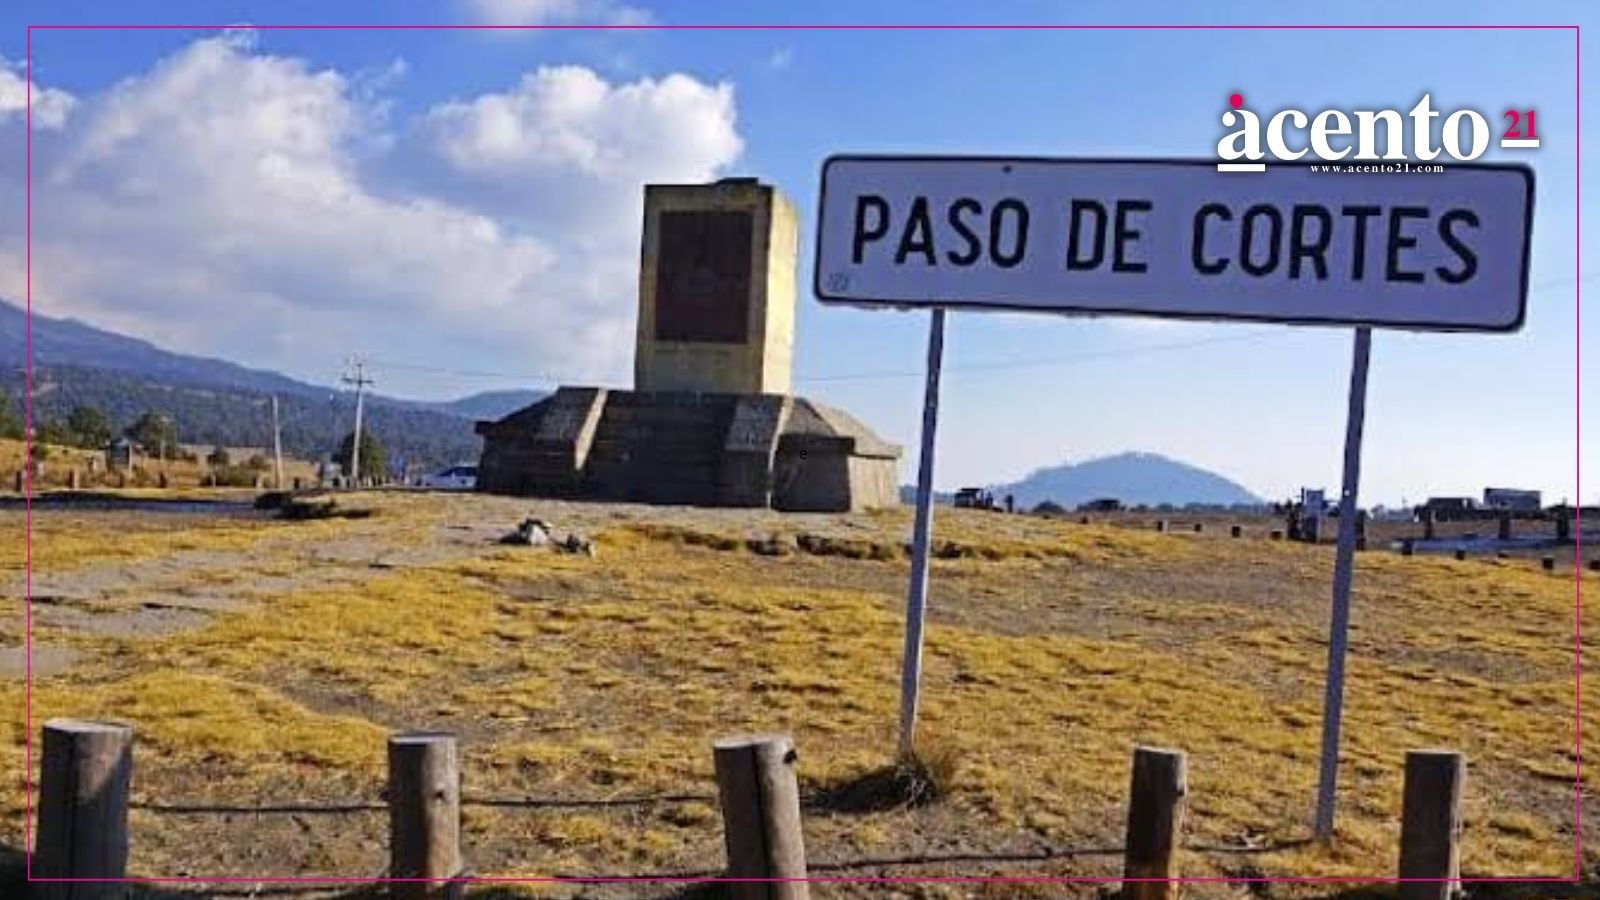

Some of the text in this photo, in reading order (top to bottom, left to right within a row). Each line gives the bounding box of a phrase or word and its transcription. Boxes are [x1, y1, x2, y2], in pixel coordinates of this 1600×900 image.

[851, 194, 1481, 285] PASO DE CORTES
